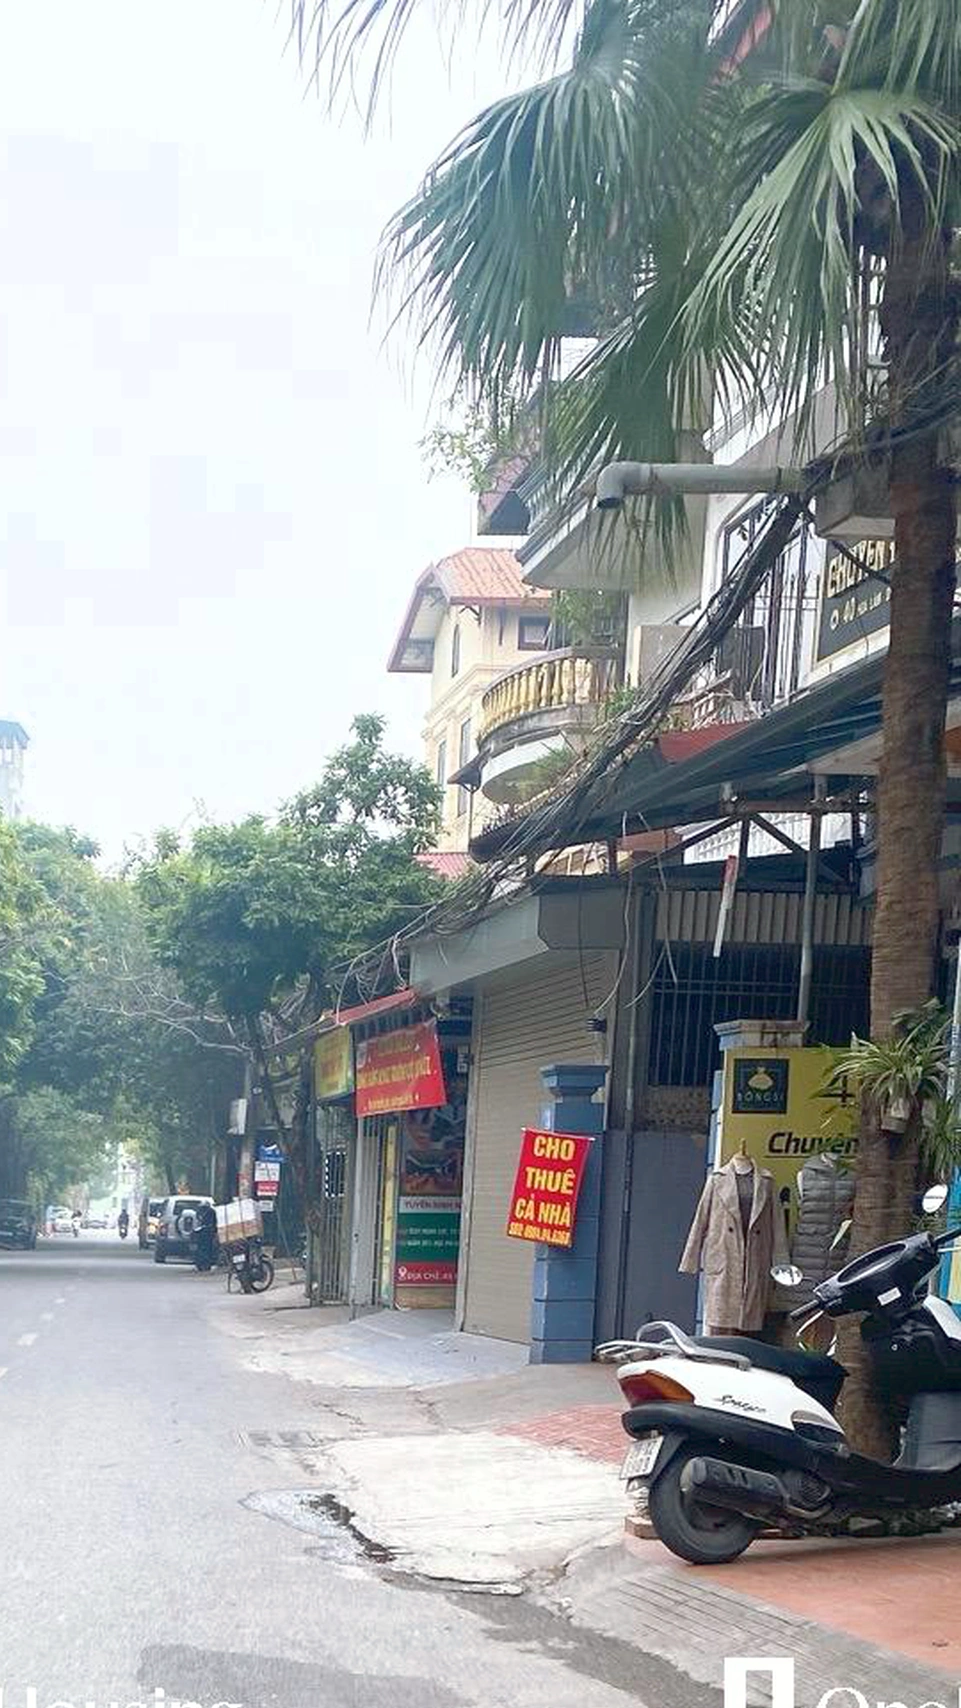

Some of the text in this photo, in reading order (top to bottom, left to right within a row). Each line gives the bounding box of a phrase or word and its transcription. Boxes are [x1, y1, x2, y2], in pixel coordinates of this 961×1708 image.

[533, 1135, 576, 1161] CHO
[525, 1166, 576, 1195] THUÊ
[538, 1201, 571, 1228] NHÀ
